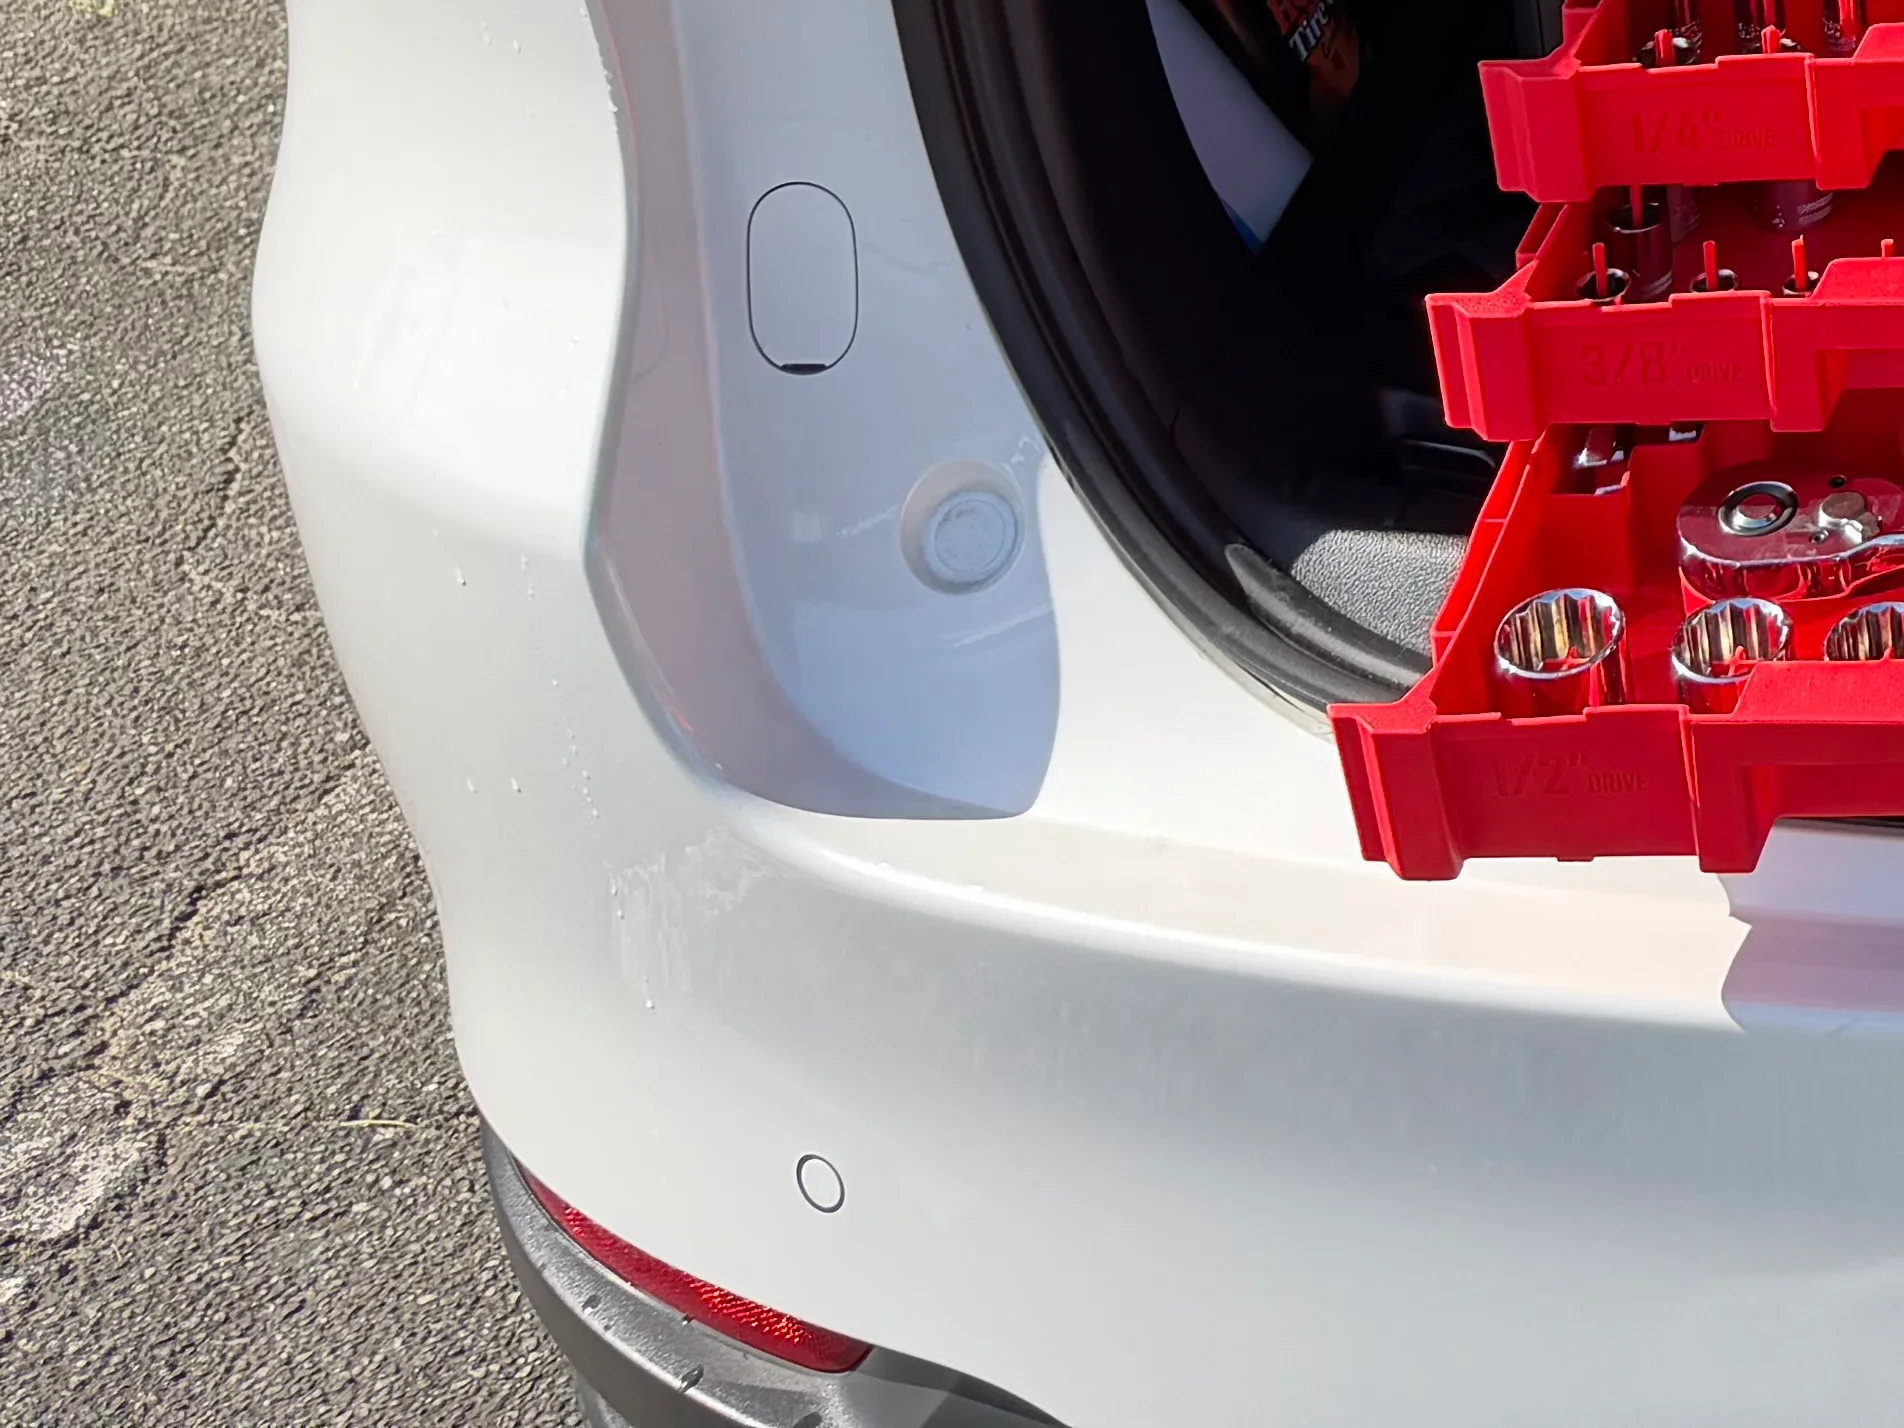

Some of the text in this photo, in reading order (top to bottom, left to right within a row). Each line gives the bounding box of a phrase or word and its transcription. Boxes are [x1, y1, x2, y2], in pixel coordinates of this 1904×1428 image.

[1721, 128, 1773, 150] DRIVE
[1689, 359, 1743, 384] DRIVE
[1590, 772, 1648, 796] DRIVE
